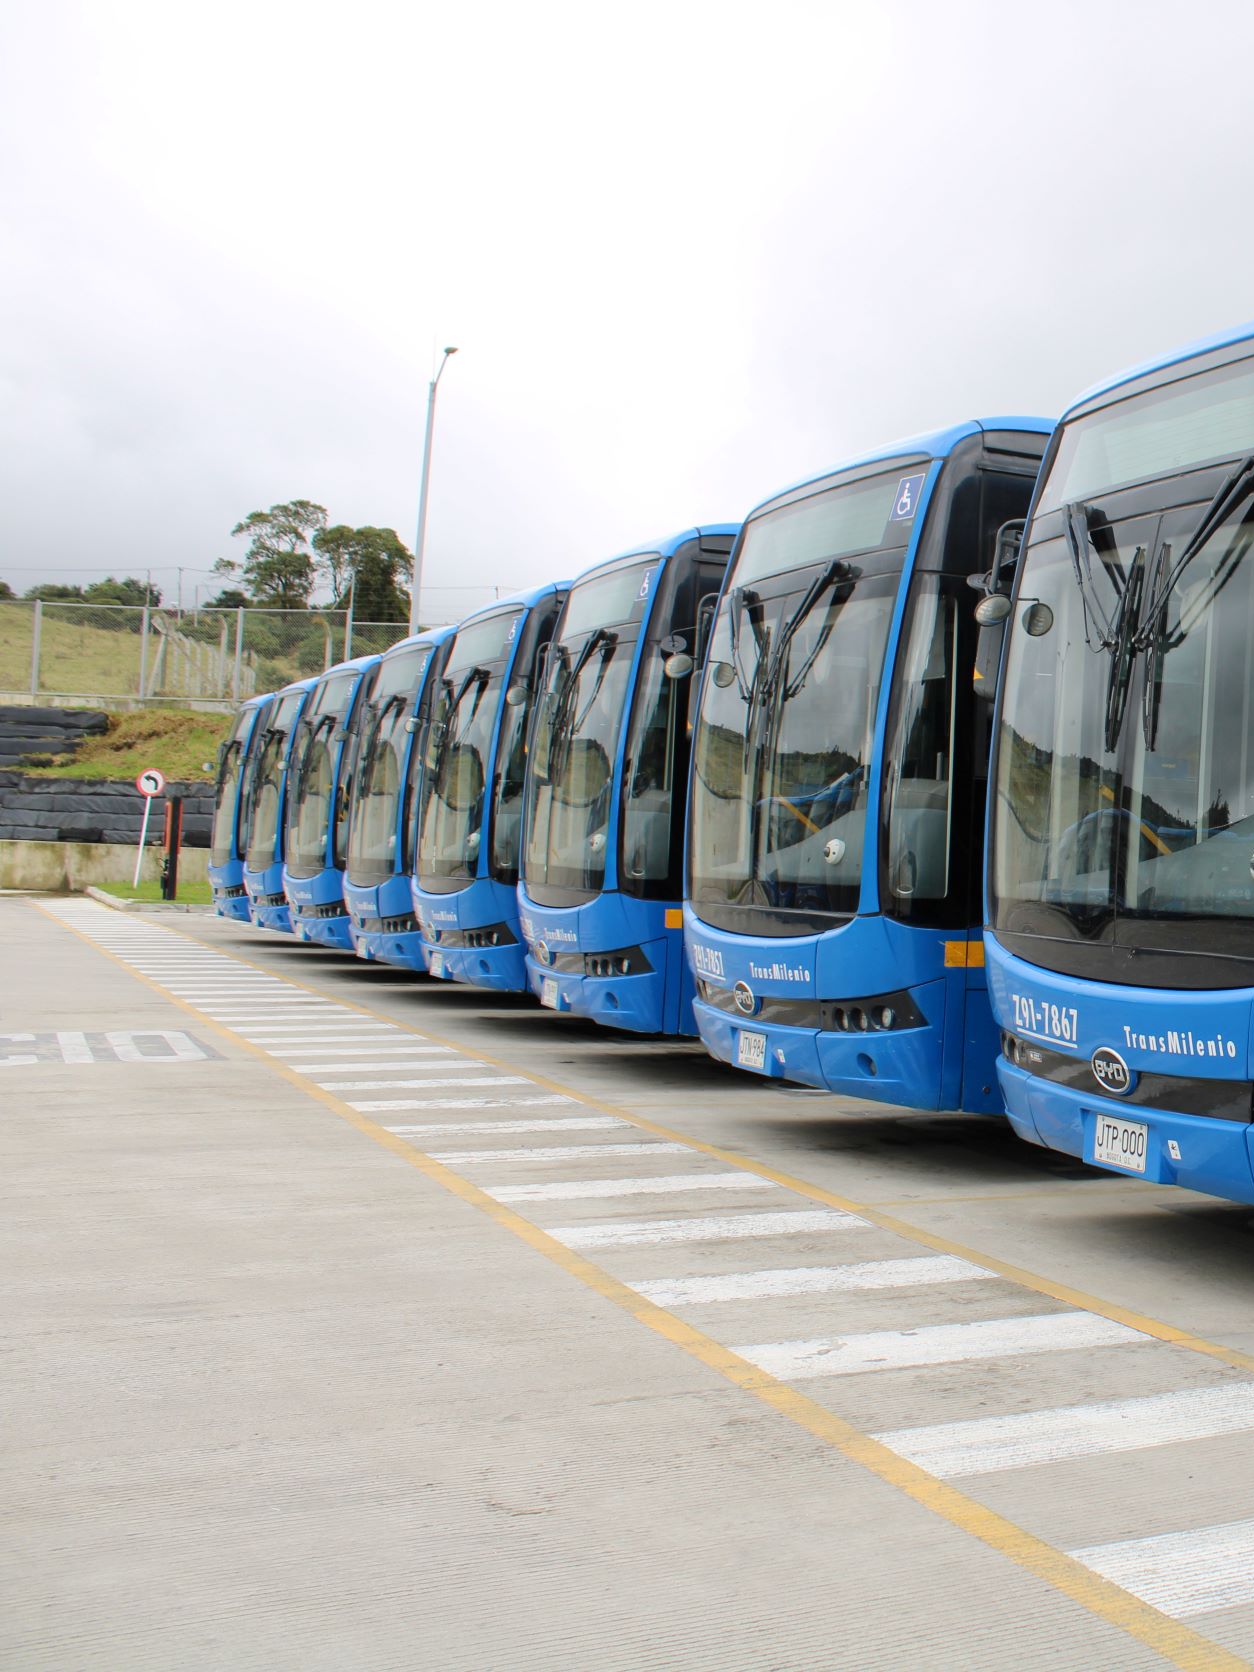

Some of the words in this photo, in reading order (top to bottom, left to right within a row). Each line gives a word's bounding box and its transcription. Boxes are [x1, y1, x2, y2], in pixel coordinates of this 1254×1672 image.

[749, 962, 811, 982] TransMilenio
[1013, 994, 1078, 1042] Z91-7867
[1123, 1026, 1236, 1058] TransMilenio
[1095, 1059, 1126, 1082] BYD
[1097, 1123, 1119, 1152] JTP
[1121, 1130, 1145, 1157] 000
